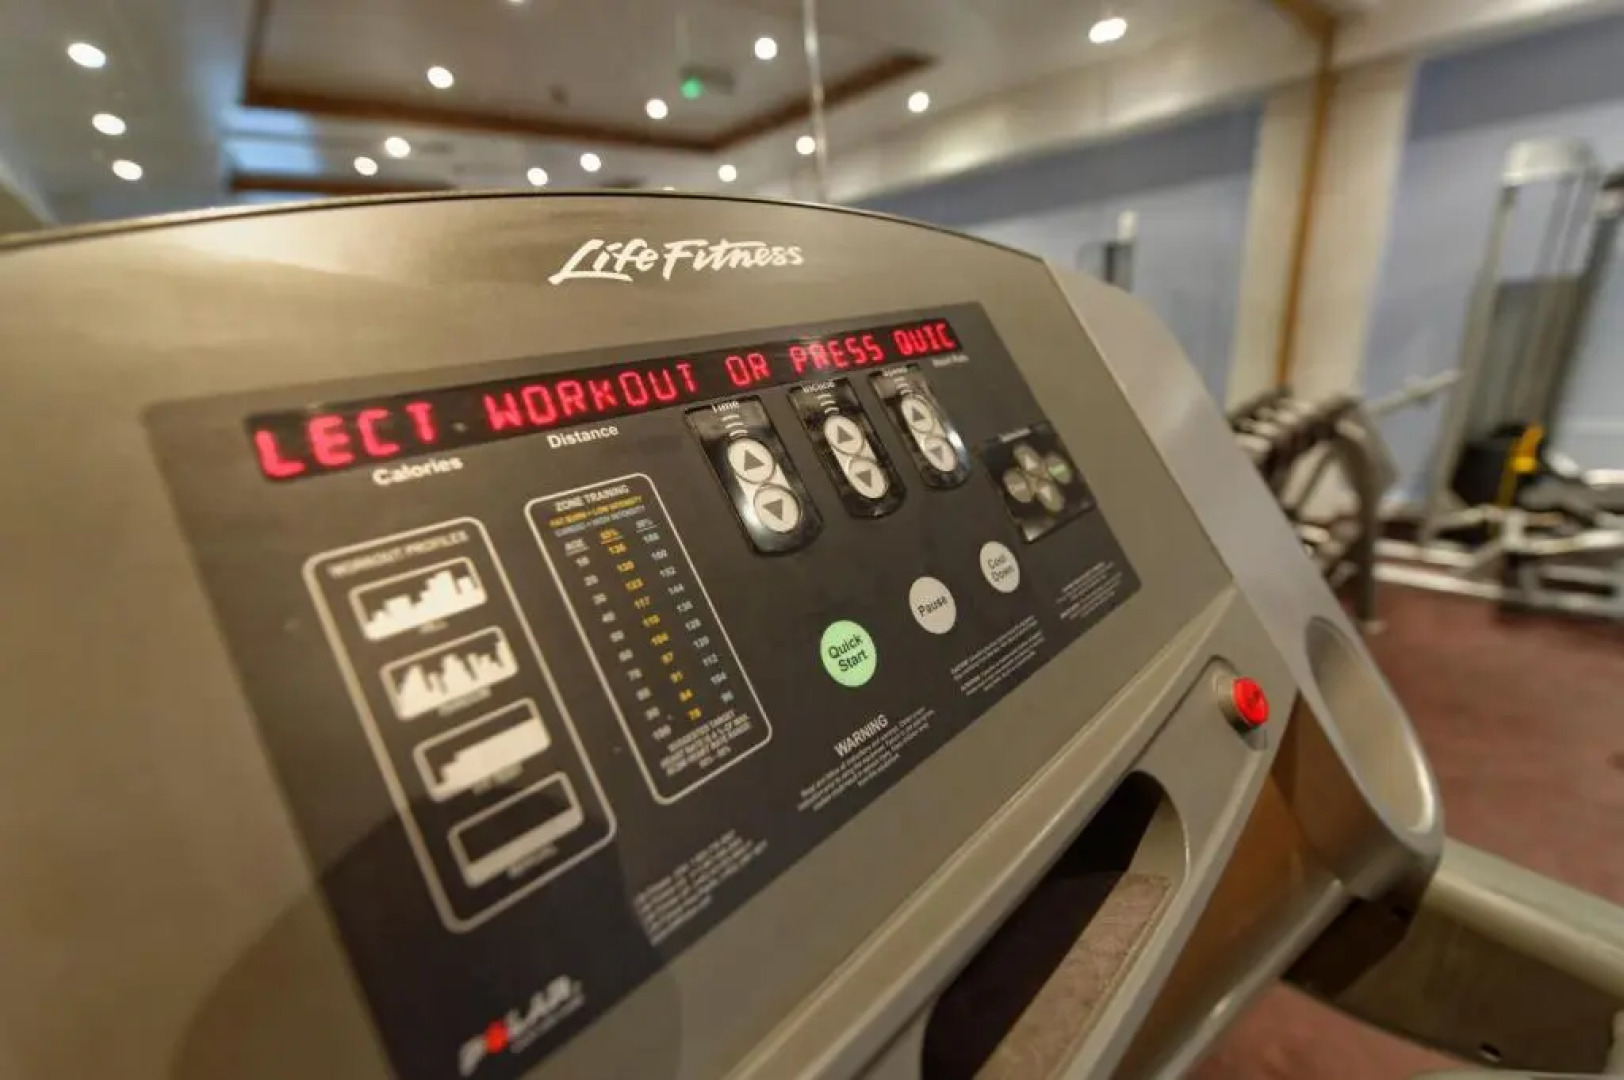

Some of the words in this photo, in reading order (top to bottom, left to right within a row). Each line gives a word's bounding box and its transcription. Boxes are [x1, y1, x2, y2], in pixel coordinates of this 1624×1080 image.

[548, 238, 660, 285] Life
[662, 239, 804, 280] Fitness
[252, 402, 438, 480] LECT
[484, 361, 698, 432] WORKOUT
[724, 352, 772, 388] OR
[788, 334, 886, 374] PRESS
[546, 424, 620, 450] Distance
[371, 455, 464, 486] Calories
[917, 596, 948, 618] Pause
[828, 634, 864, 660] Quick
[838, 649, 869, 672] Start
[834, 713, 889, 757] WARNING
